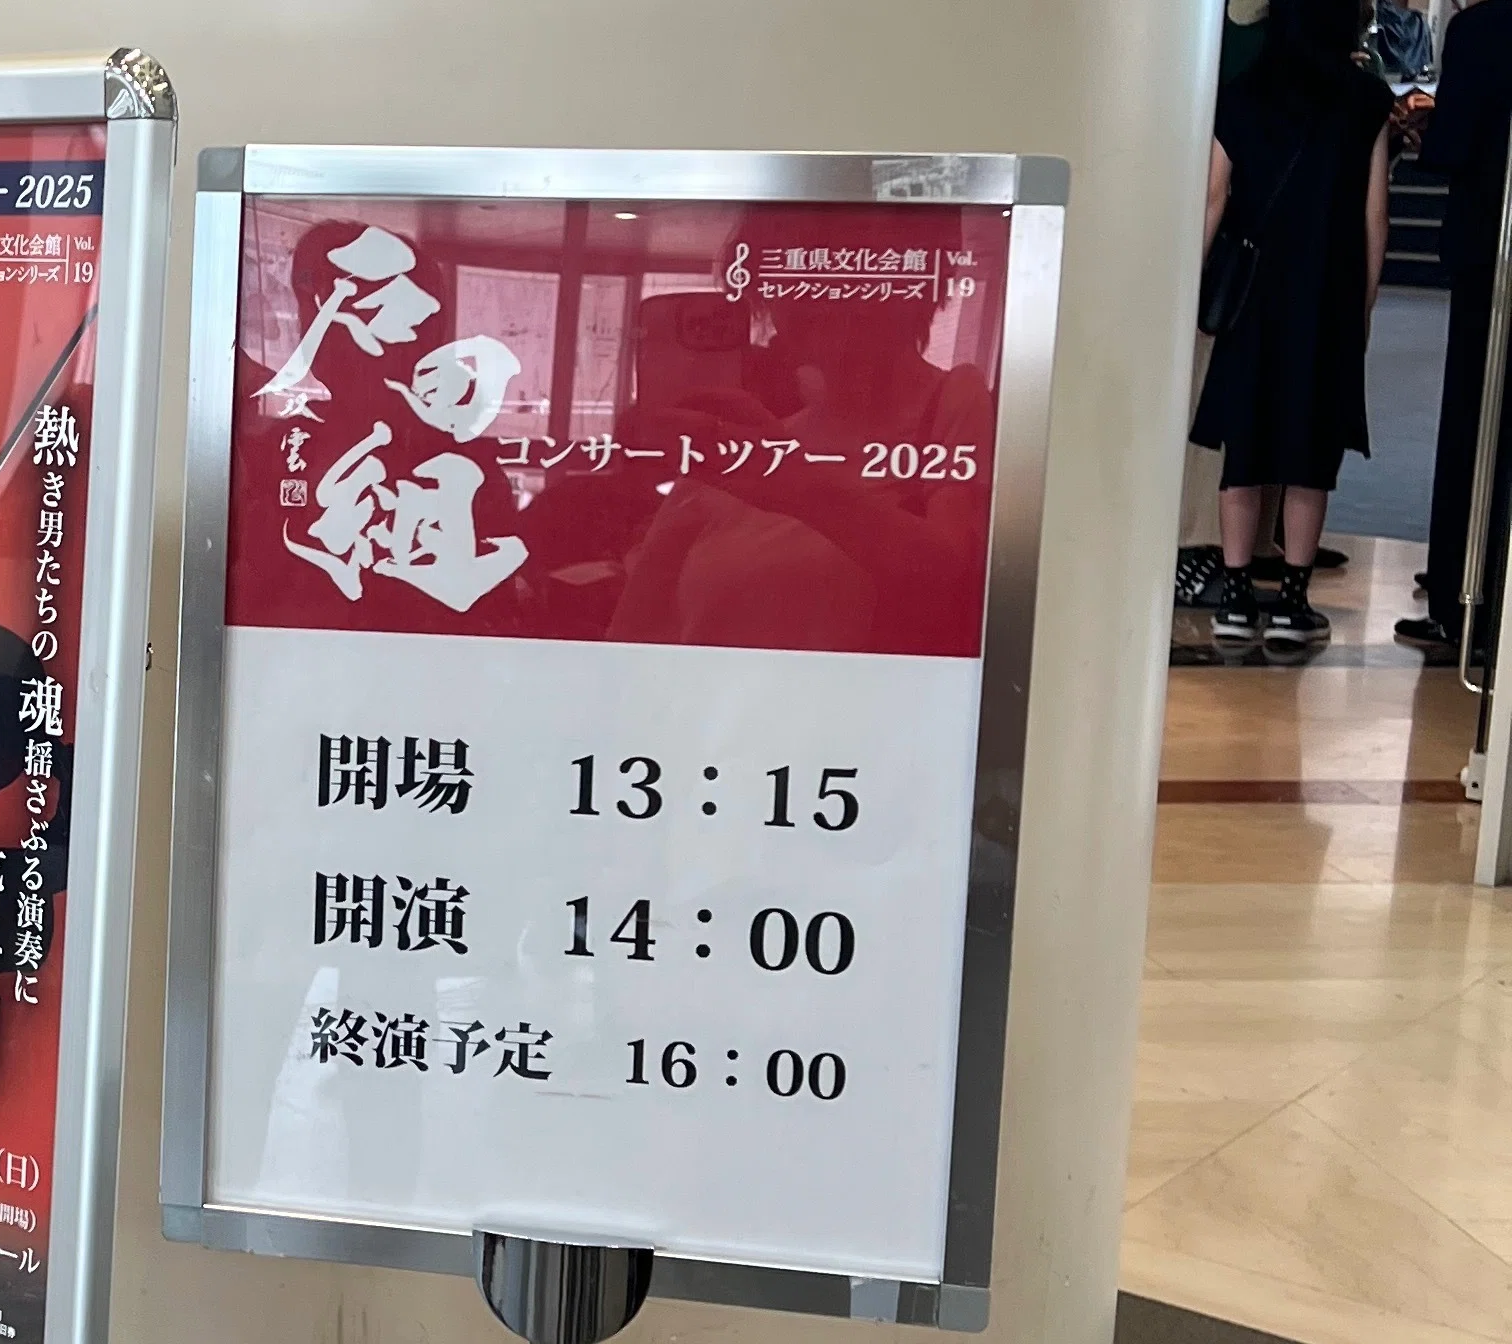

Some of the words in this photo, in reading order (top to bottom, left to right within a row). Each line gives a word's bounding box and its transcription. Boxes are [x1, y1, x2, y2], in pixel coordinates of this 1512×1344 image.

[15, 174, 94, 208] 2025
[74, 236, 95, 251] Vol.
[759, 247, 928, 272] 三重県文化会館
[947, 251, 977, 267] Vol.
[73, 262, 93, 283] 19
[757, 281, 926, 302] セレクションシリーズ
[946, 276, 975, 297] 19
[495, 432, 846, 477] コンサートツアー
[861, 442, 977, 480] 2025
[317, 733, 474, 814] 開場
[569, 754, 859, 831] 13:15
[313, 871, 470, 955] 開演
[564, 896, 855, 975] 14:00
[310, 1007, 553, 1081] 終演予定
[626, 1038, 847, 1100] 16:00
